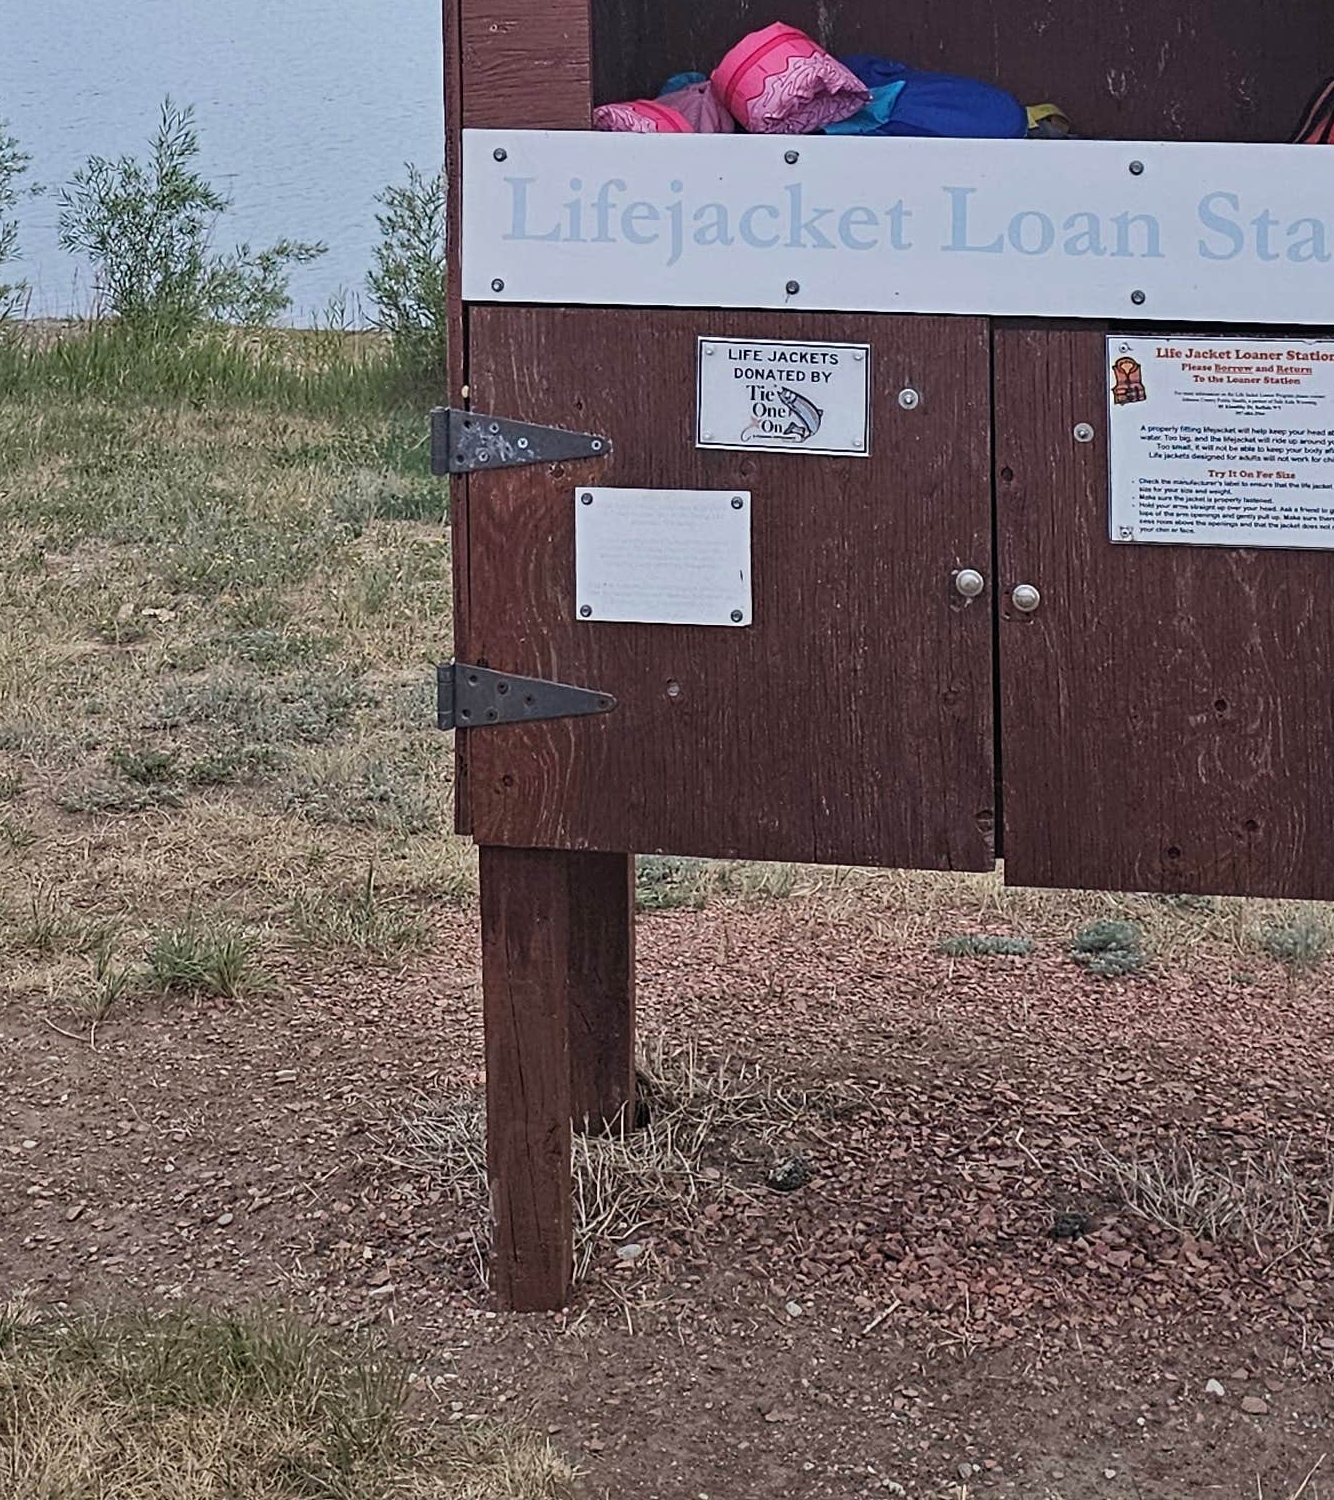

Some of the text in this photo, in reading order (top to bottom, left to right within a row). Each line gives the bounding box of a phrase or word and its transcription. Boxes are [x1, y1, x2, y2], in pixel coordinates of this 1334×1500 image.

[502, 177, 913, 267] Lifejacket
[941, 187, 1165, 257] Loan
[729, 349, 838, 364] LIFE JACKETS
[1156, 348, 1181, 358] Life
[1185, 348, 1230, 358] Jacket
[1235, 350, 1283, 359] Loaner
[734, 368, 831, 382] DONATED BY
[1214, 364, 1252, 373] Borrow
[1276, 365, 1311, 374] Return
[1263, 376, 1300, 384] Station
[746, 385, 775, 402] Tie
[752, 402, 786, 418] One
[761, 419, 783, 433] On
[1208, 470, 1225, 478] Try
[1256, 470, 1273, 478] For
